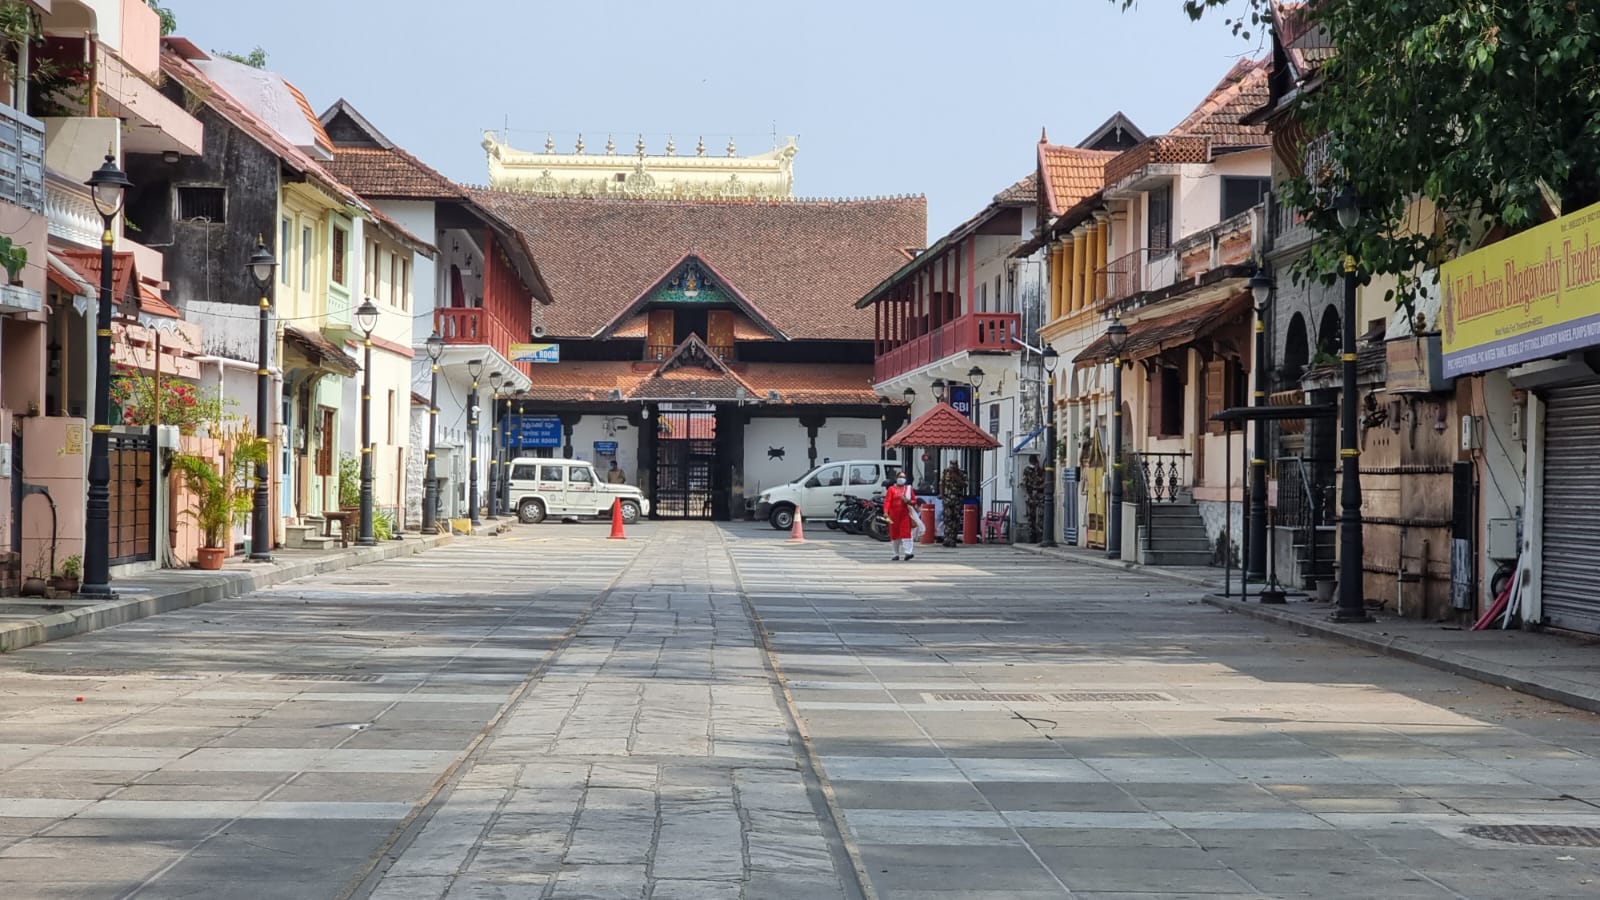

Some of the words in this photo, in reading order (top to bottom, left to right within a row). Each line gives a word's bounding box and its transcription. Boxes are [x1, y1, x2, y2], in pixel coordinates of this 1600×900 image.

[1505, 246, 1561, 313] Bhagavathy
[539, 350, 558, 359] ROOM
[952, 402, 969, 412] SBI
